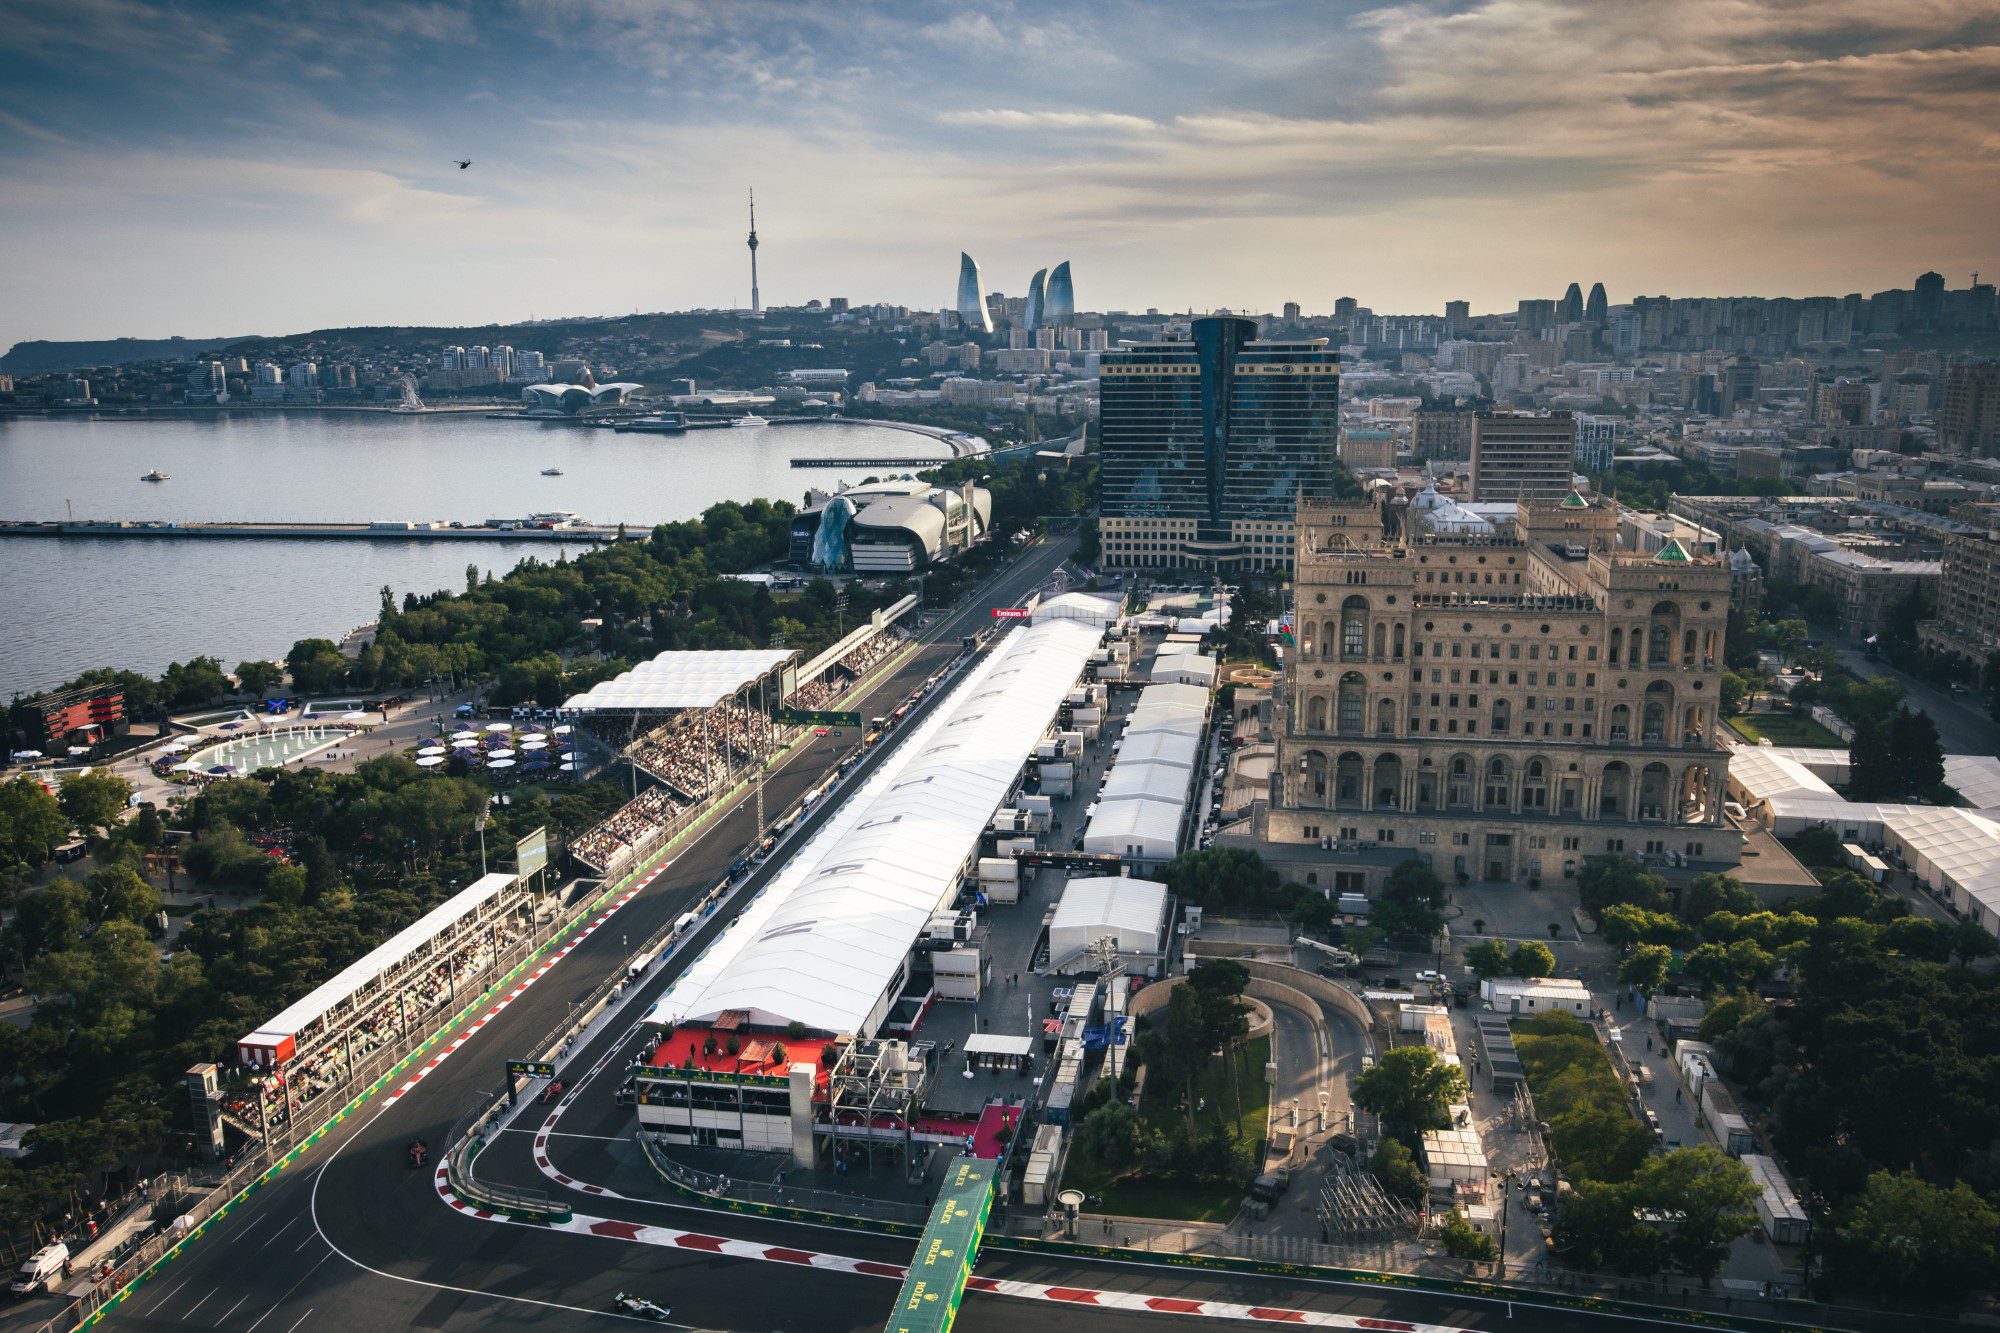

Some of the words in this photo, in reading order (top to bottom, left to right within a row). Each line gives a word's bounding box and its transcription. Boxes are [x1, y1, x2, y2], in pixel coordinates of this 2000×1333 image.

[954, 1164, 970, 1187] ROLEX
[940, 1200, 957, 1224] ROLEX
[924, 1238, 943, 1266] ROLEX
[907, 1281, 927, 1311] ROLEX
